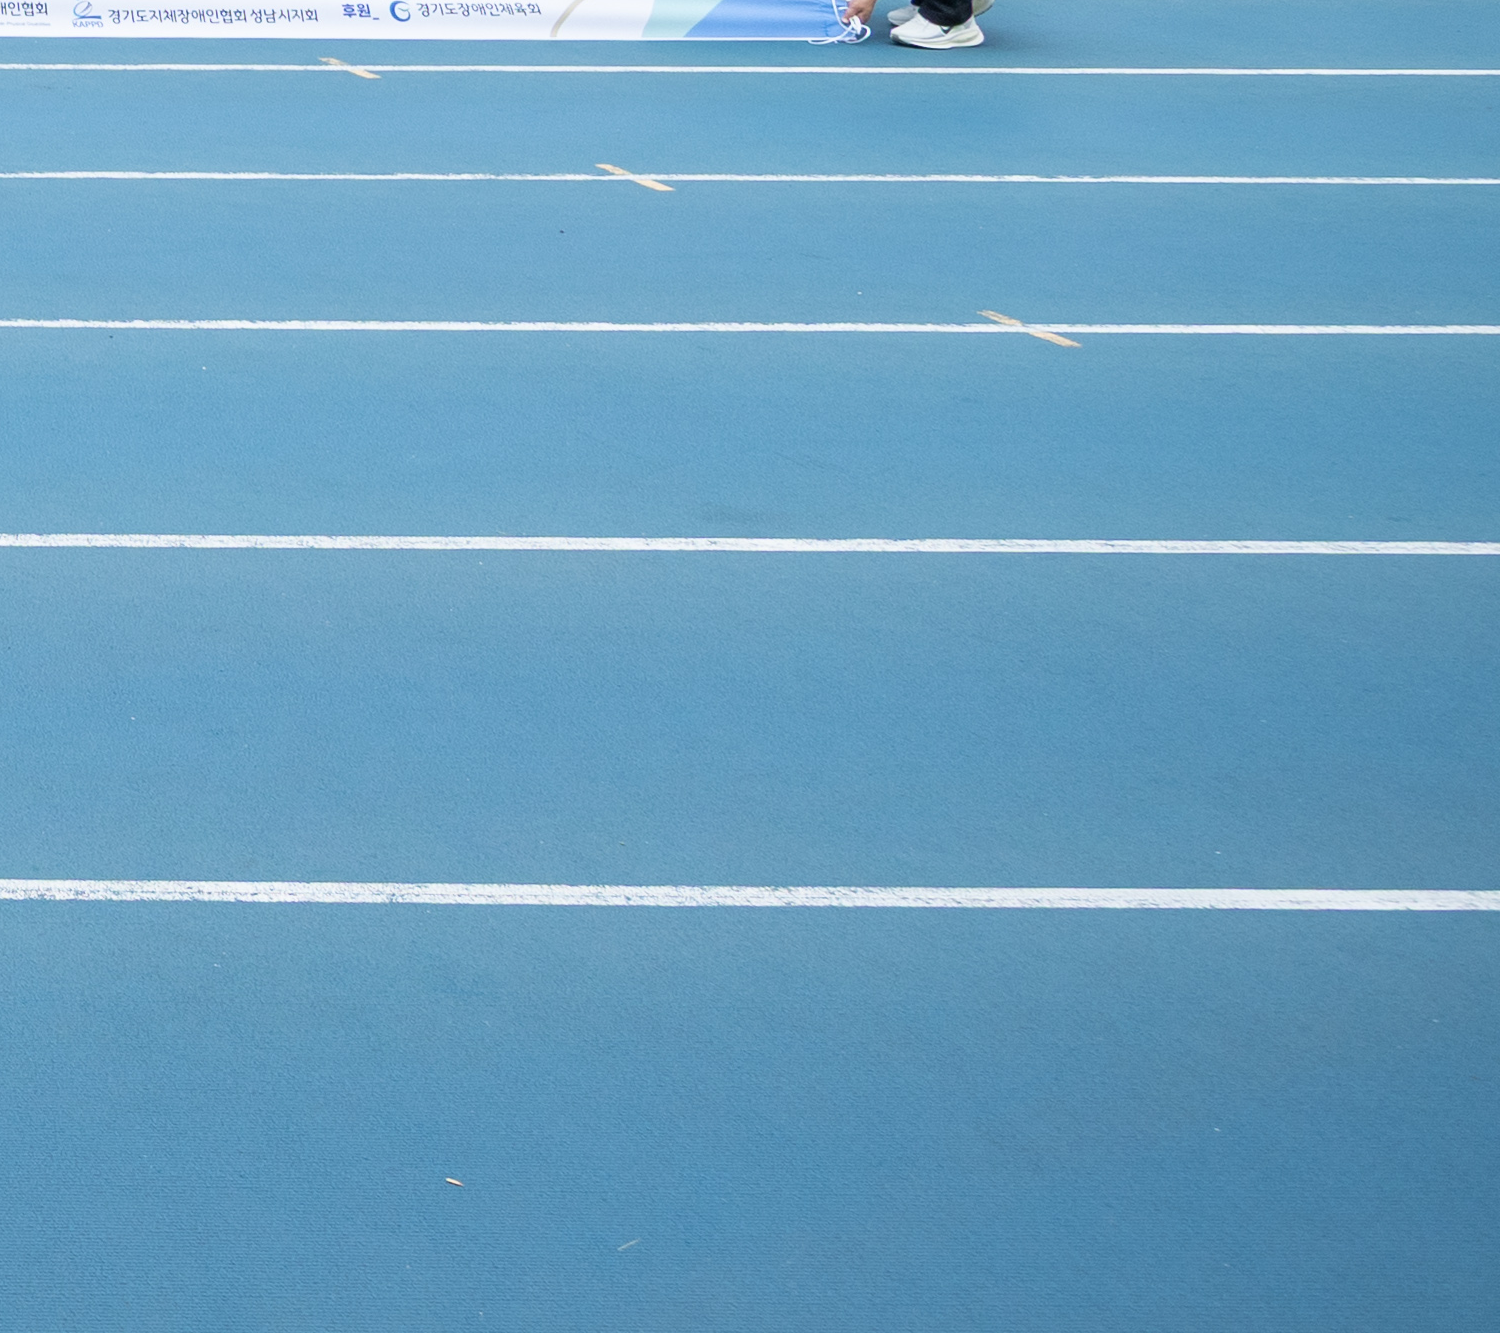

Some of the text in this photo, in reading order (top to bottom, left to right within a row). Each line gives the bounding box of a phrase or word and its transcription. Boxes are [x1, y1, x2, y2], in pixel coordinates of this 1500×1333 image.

[108, 8, 319, 24] 경기도지체장애인협회 성남시지회
[416, 1, 542, 18] 경기도장애인체육회
[71, 20, 104, 28] KAPPD
